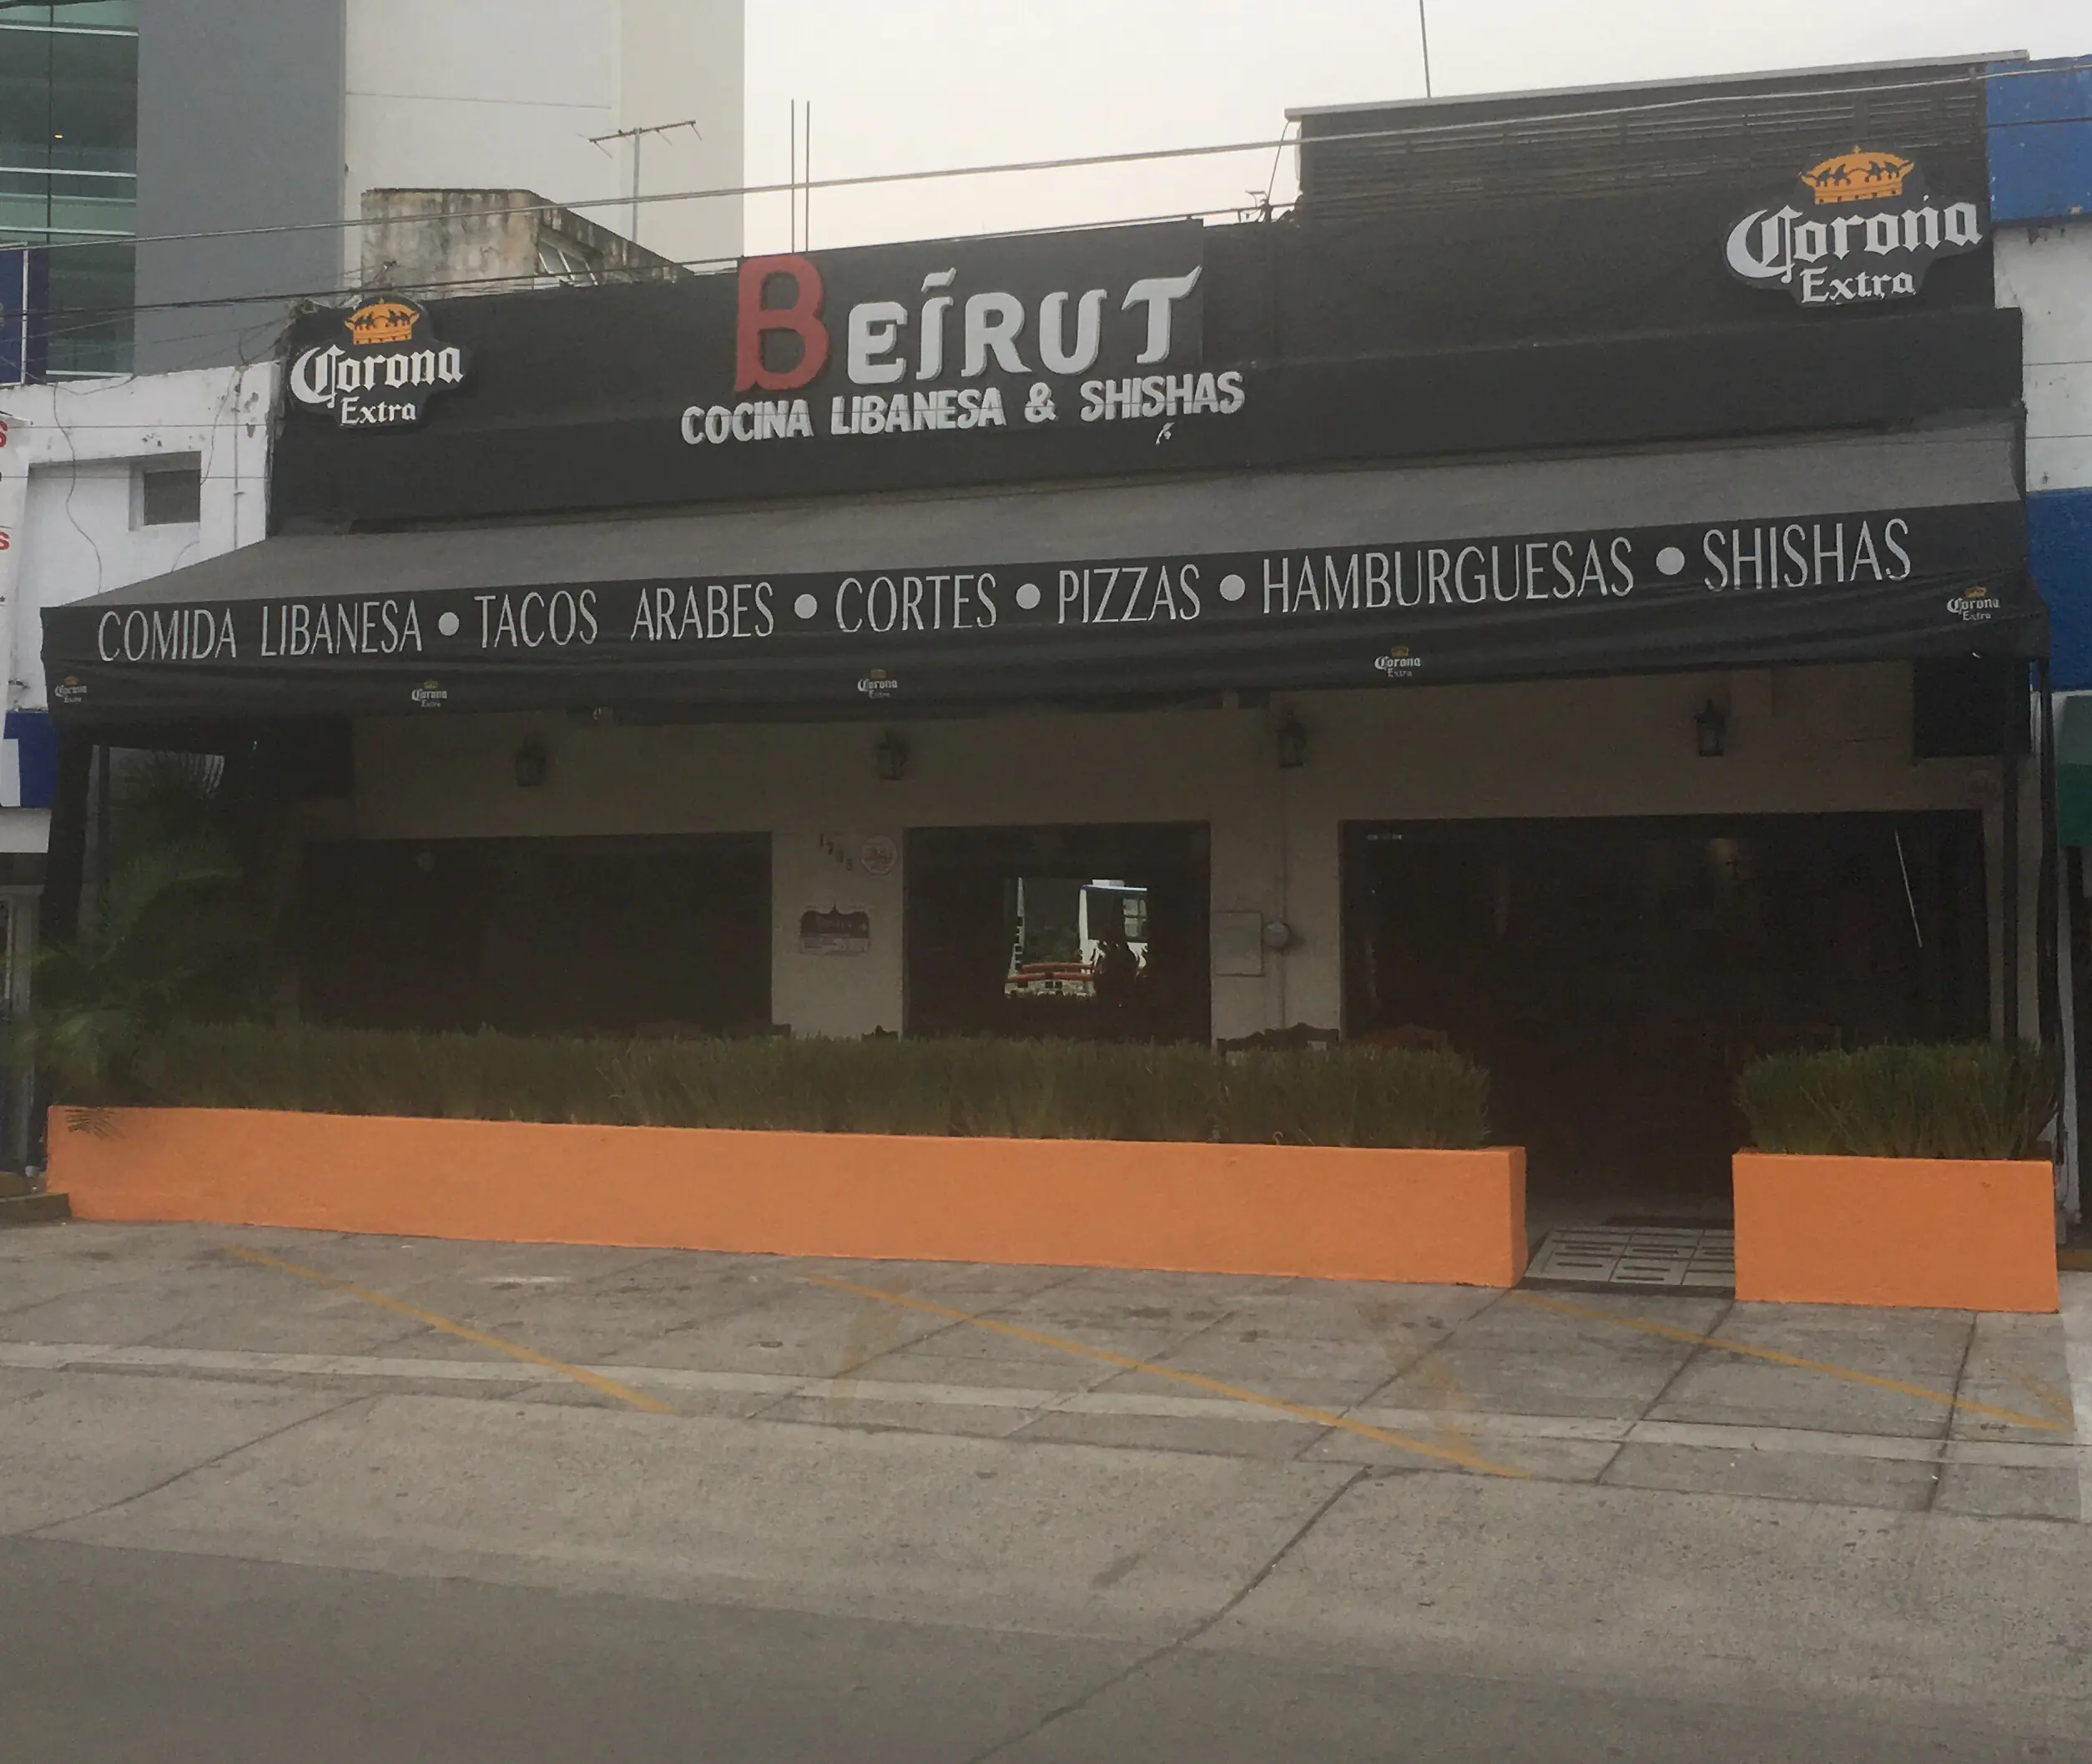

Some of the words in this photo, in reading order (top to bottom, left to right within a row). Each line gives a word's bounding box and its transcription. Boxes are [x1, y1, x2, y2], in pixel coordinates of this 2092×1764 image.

[1727, 195, 1982, 284] Corona
[1801, 266, 1916, 304] Extra
[290, 344, 463, 408] Corona
[340, 396, 416, 425] Extra
[681, 400, 814, 444] COCINA
[830, 388, 1006, 436] LIBANESA
[1024, 381, 1056, 423] &
[1081, 370, 1246, 422] SHISHAS
[98, 608, 238, 661] COMIDA
[260, 599, 422, 656] LIBANESA
[473, 589, 598, 648] TACOS
[629, 582, 774, 641] ARABES
[835, 571, 998, 632] CORTES
[1057, 563, 1201, 625] PIZZAS
[1262, 537, 1635, 614] HAMBURGUESAS
[1702, 517, 1912, 592] SHISHAS
[1947, 597, 1999, 614] Corona
[1374, 656, 1420, 671] Corona
[411, 688, 447, 701] Corona
[857, 678, 897, 692] Corona
